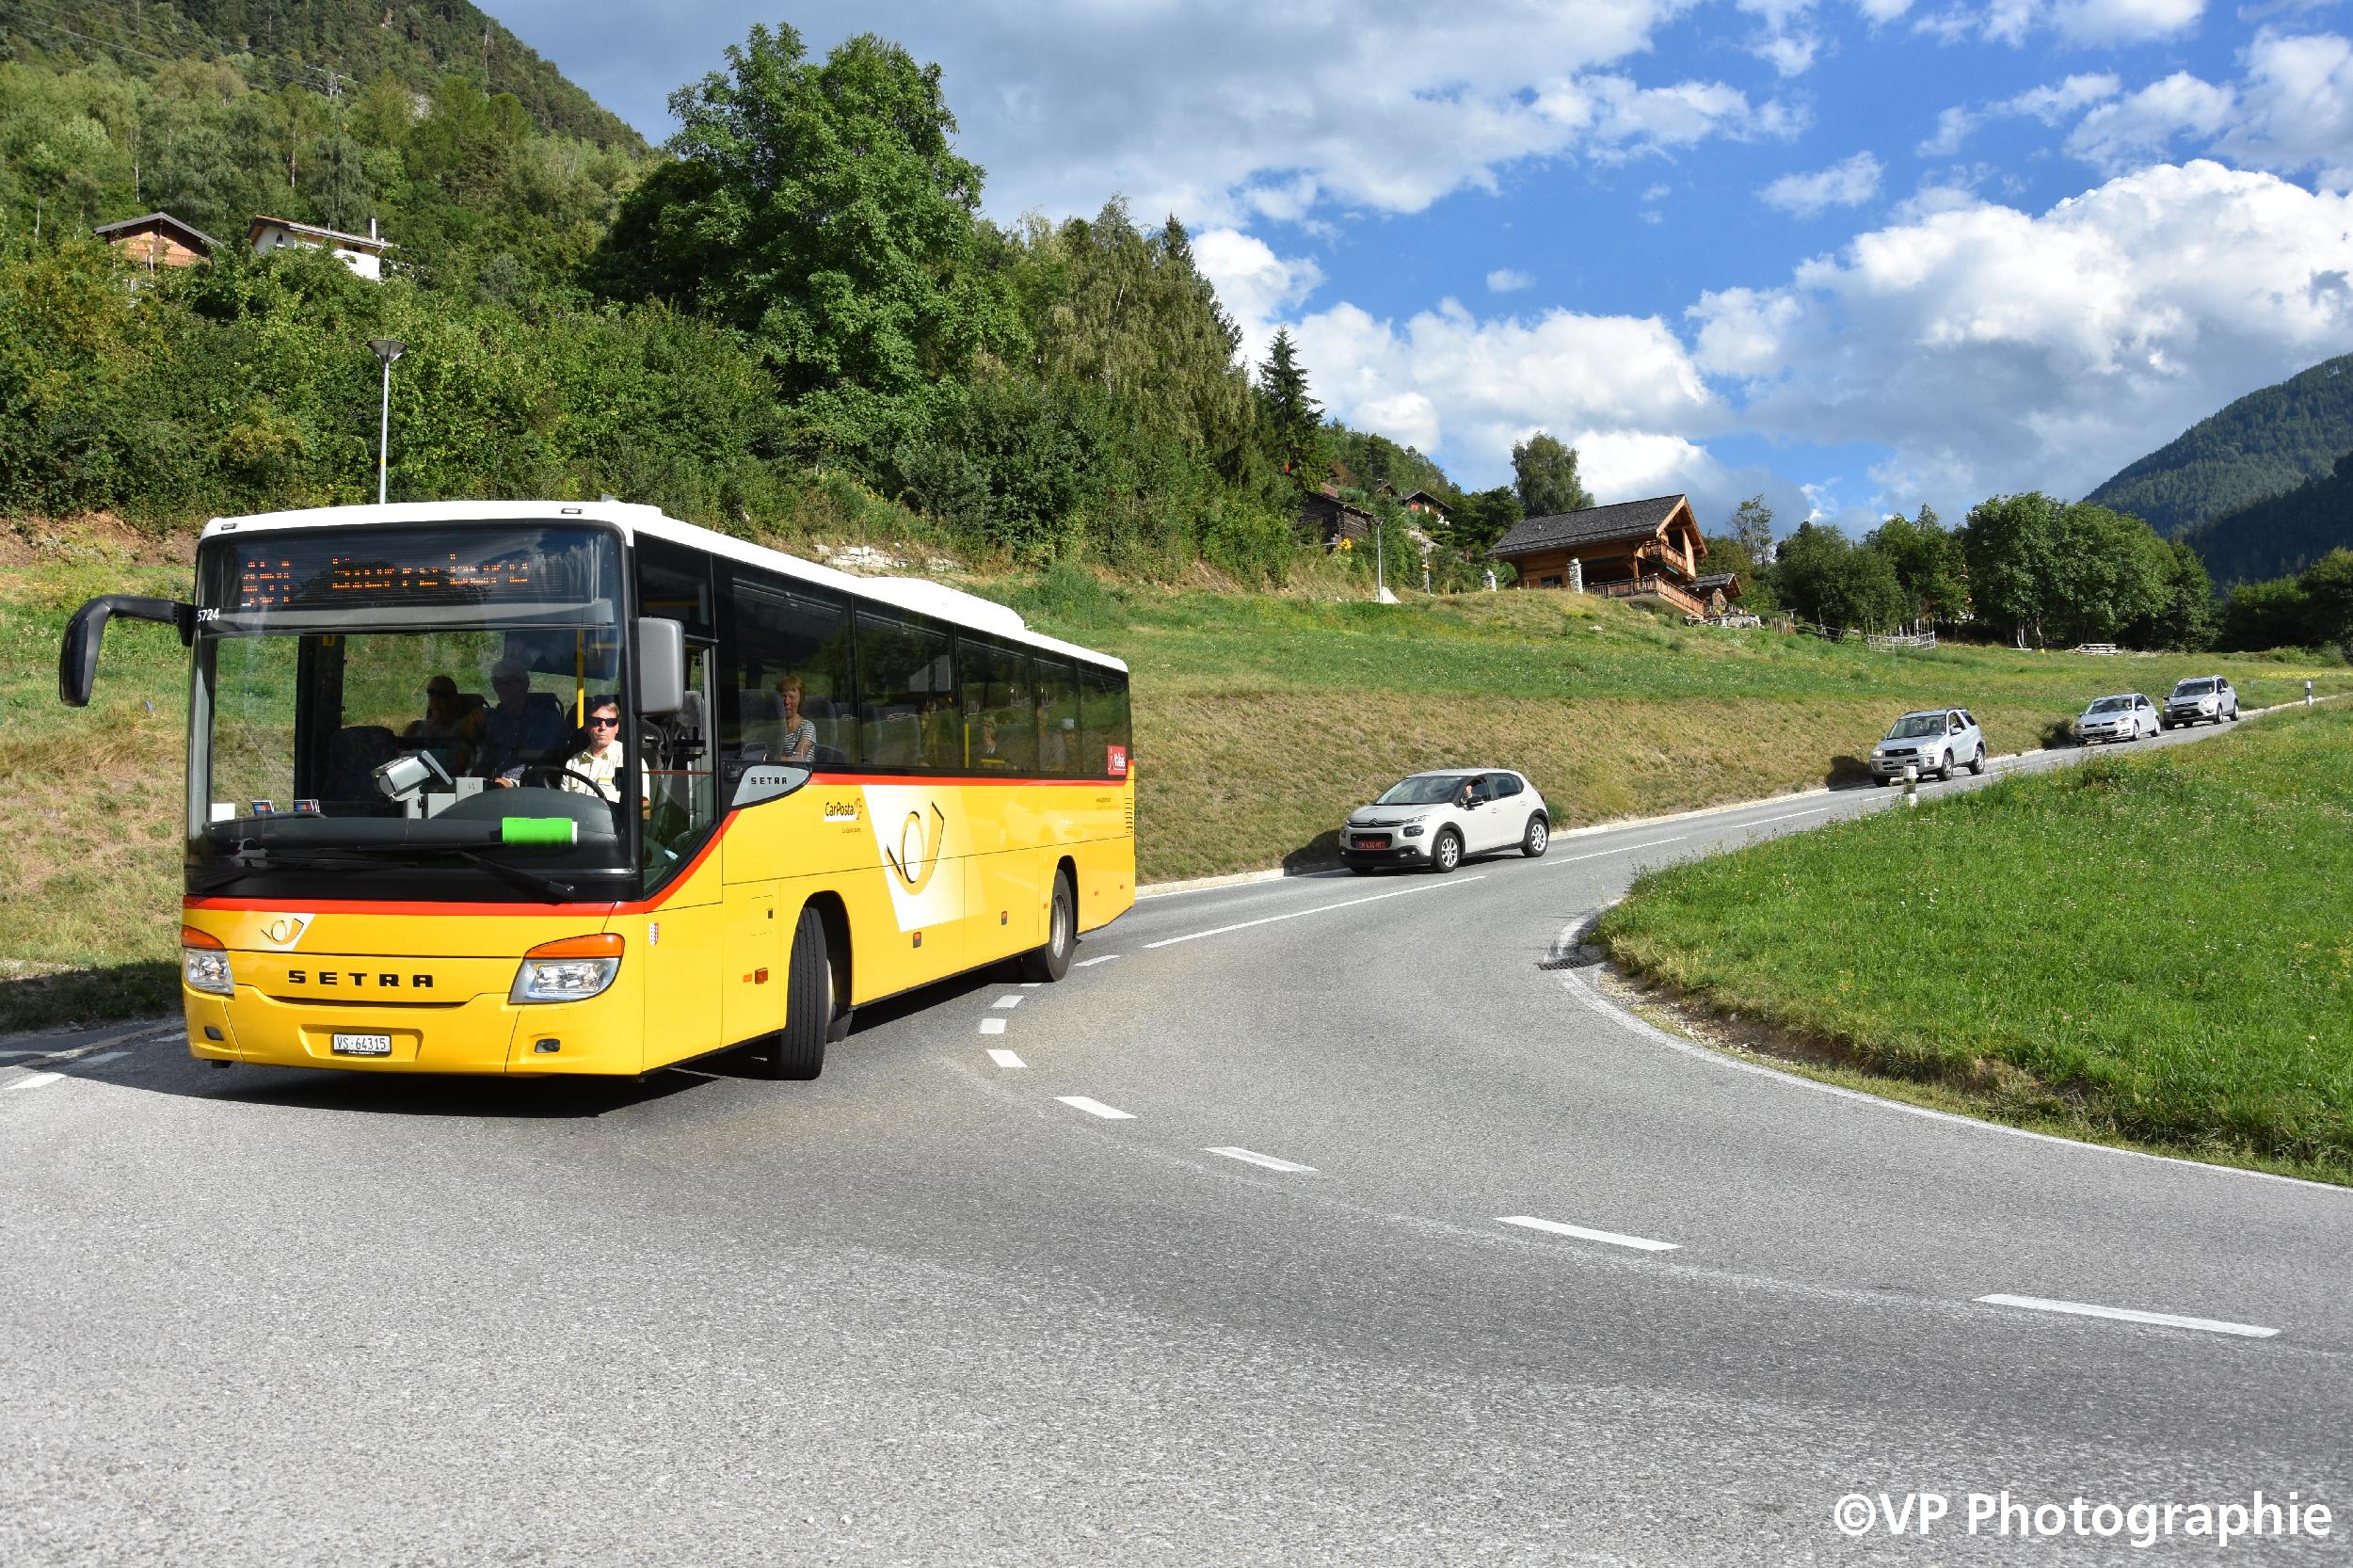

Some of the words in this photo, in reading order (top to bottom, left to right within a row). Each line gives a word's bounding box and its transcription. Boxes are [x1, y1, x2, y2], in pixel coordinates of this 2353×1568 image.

[197, 607, 220, 622] 5724
[750, 776, 788, 785] SETRA
[824, 799, 856, 818] CarPostal
[288, 969, 434, 988] SETRA
